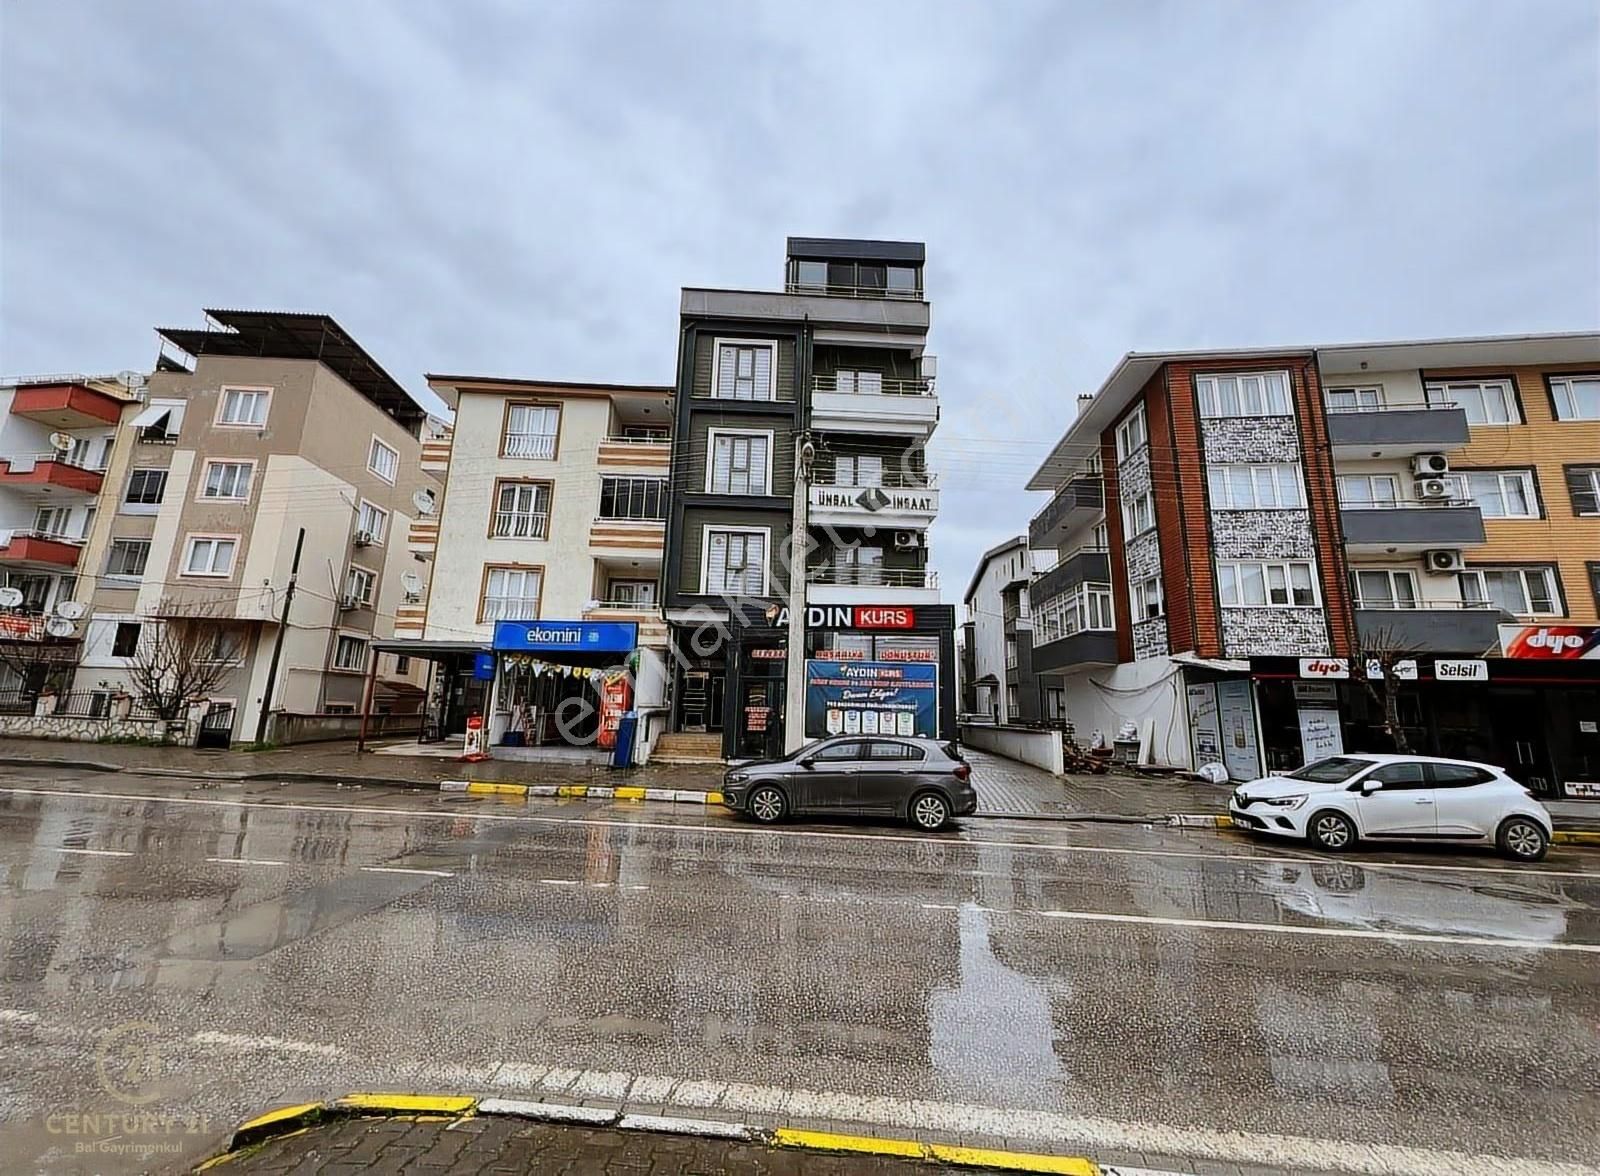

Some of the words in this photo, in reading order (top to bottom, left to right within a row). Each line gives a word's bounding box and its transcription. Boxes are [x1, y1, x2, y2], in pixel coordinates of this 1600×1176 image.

[860, 610, 908, 625] KURS
[526, 627, 581, 643] ekomini
[1526, 629, 1584, 654] dyo
[846, 667, 878, 678] AYDIN
[1307, 661, 1341, 676] dyo
[1439, 664, 1478, 677] Selsil
